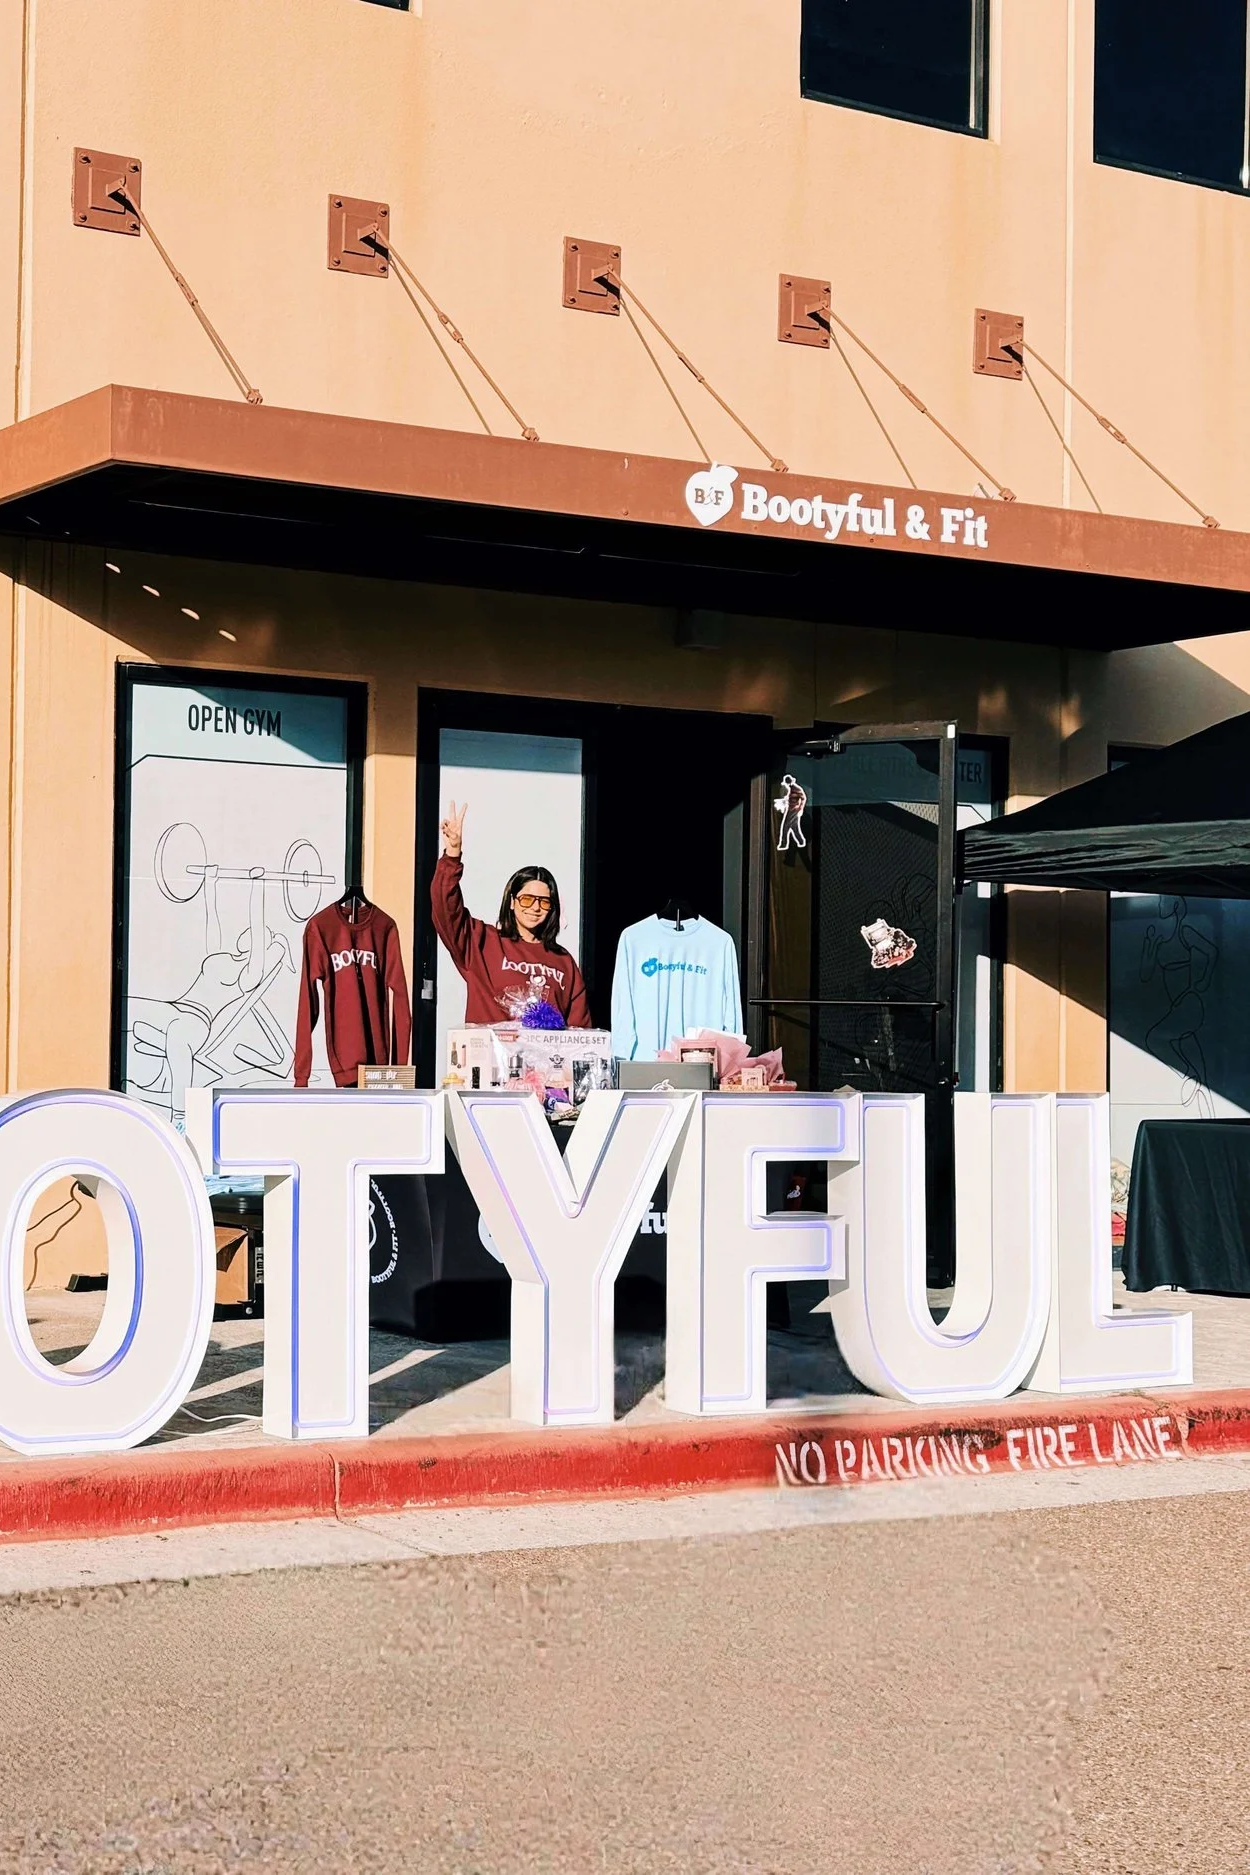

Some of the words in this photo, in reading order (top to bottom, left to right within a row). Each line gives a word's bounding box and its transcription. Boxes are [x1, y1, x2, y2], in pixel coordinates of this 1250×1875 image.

[741, 482, 897, 540] Bootyful
[905, 504, 932, 541] &
[940, 507, 989, 549] Fit
[188, 704, 237, 734] OPEN
[243, 707, 282, 738] GYM
[543, 1034, 591, 1045] APPLIANCE
[592, 1036, 607, 1045] SET
[776, 1441, 827, 1487] NO
[835, 1432, 991, 1482] PARKING
[1006, 1424, 1086, 1471] FIRE
[1088, 1416, 1182, 1463] LANE
